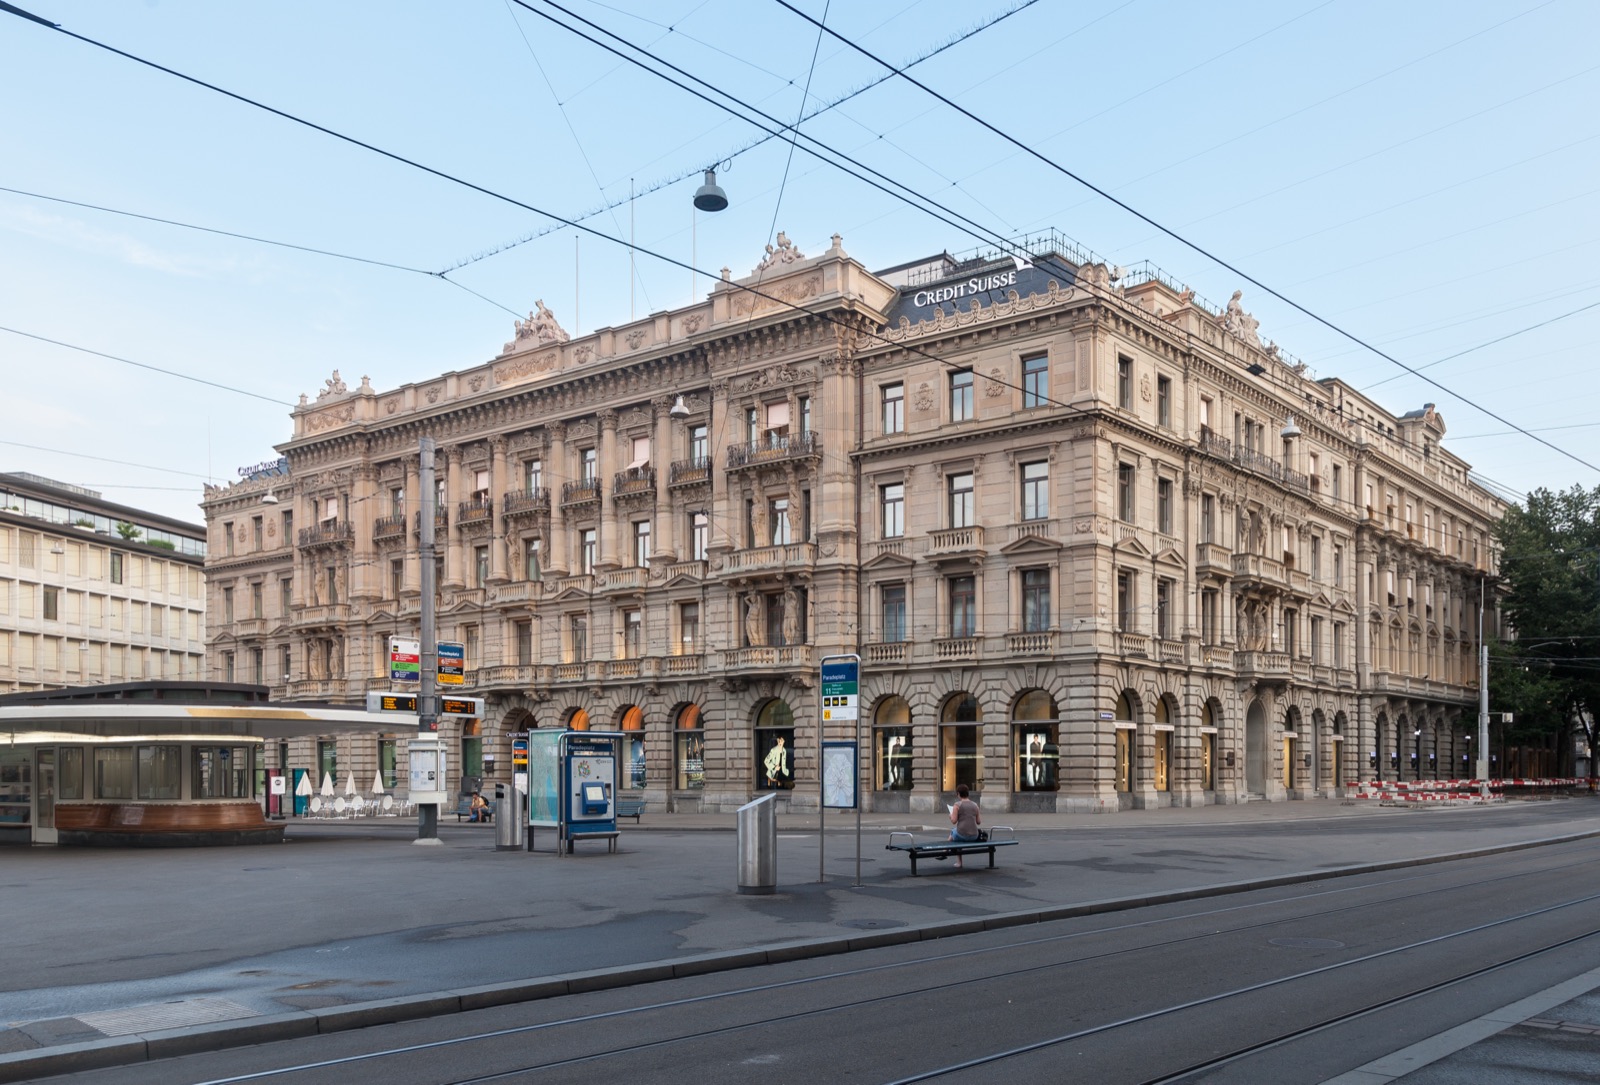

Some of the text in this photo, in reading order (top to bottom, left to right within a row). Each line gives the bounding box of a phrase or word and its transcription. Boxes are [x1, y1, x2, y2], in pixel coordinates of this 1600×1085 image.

[914, 271, 1017, 307] CREDIT SUISSE
[825, 711, 830, 719] 21
